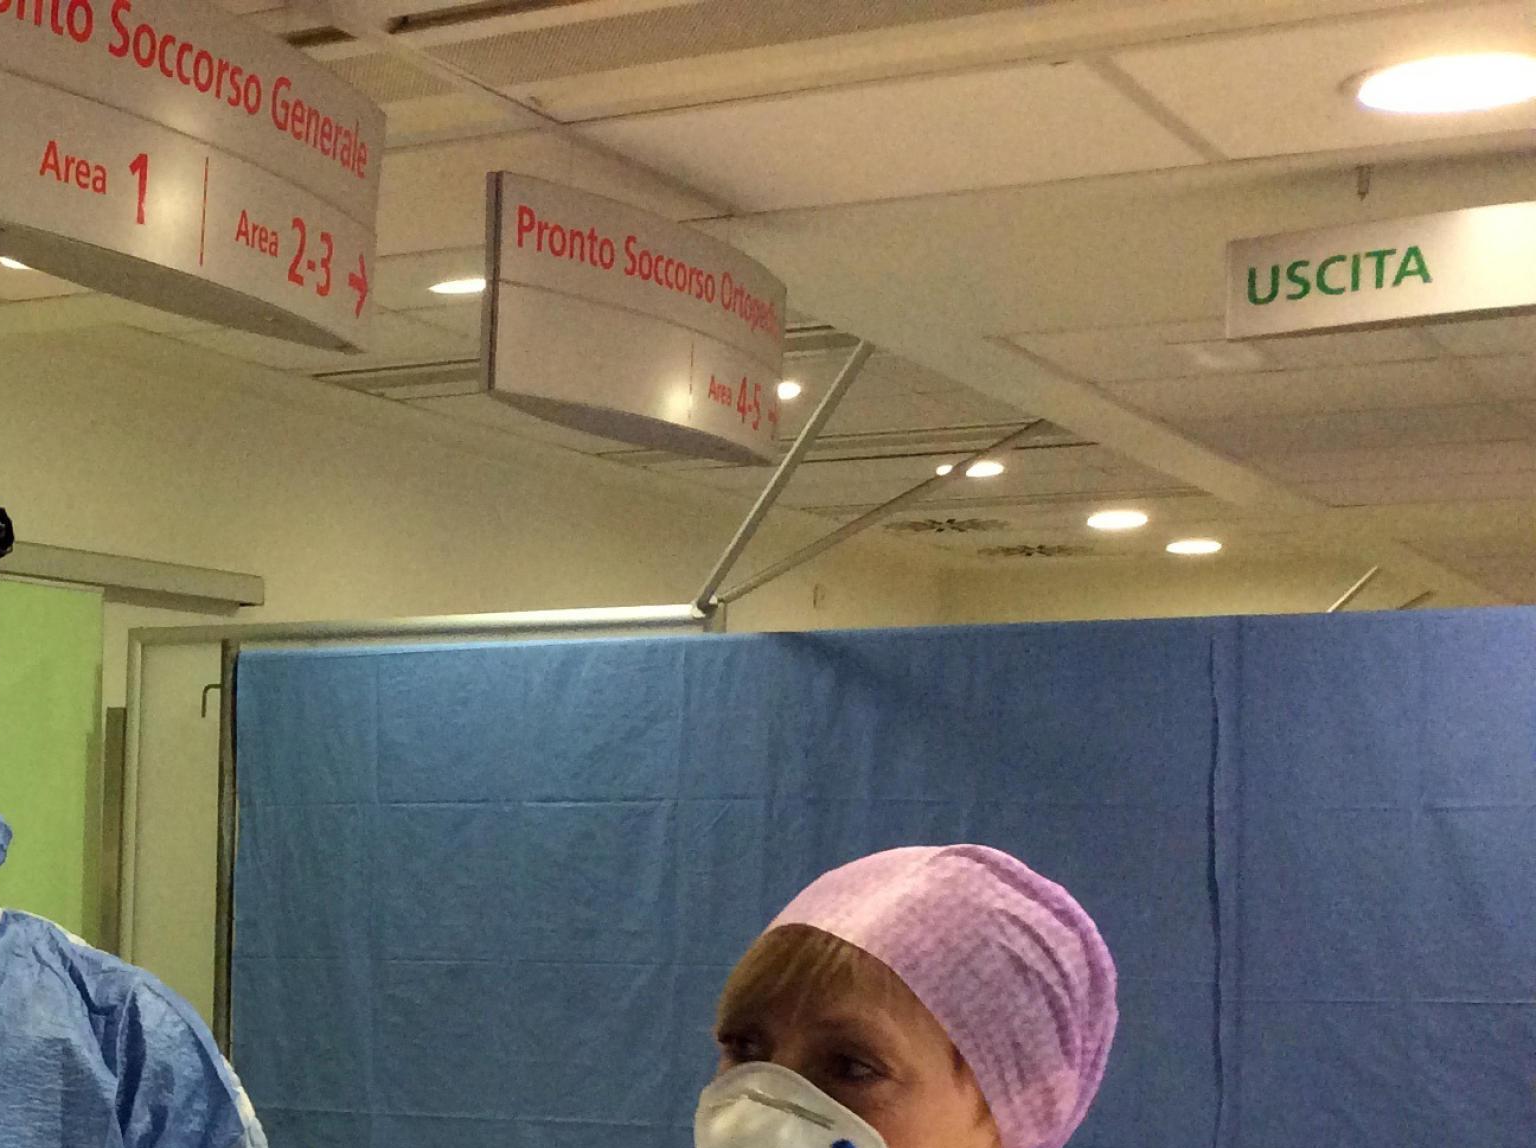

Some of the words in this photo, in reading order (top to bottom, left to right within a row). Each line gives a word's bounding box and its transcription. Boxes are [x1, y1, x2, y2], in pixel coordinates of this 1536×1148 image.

[108, 0, 262, 115] Soccorso
[271, 76, 369, 180] Generale
[39, 139, 107, 196] Area
[129, 153, 149, 225] 1
[235, 209, 279, 257] Area
[288, 216, 334, 297] 2-3
[517, 204, 615, 270] Pronto
[624, 235, 715, 304] Soccorso
[1247, 245, 1432, 305] USCITA
[708, 375, 732, 407] Area
